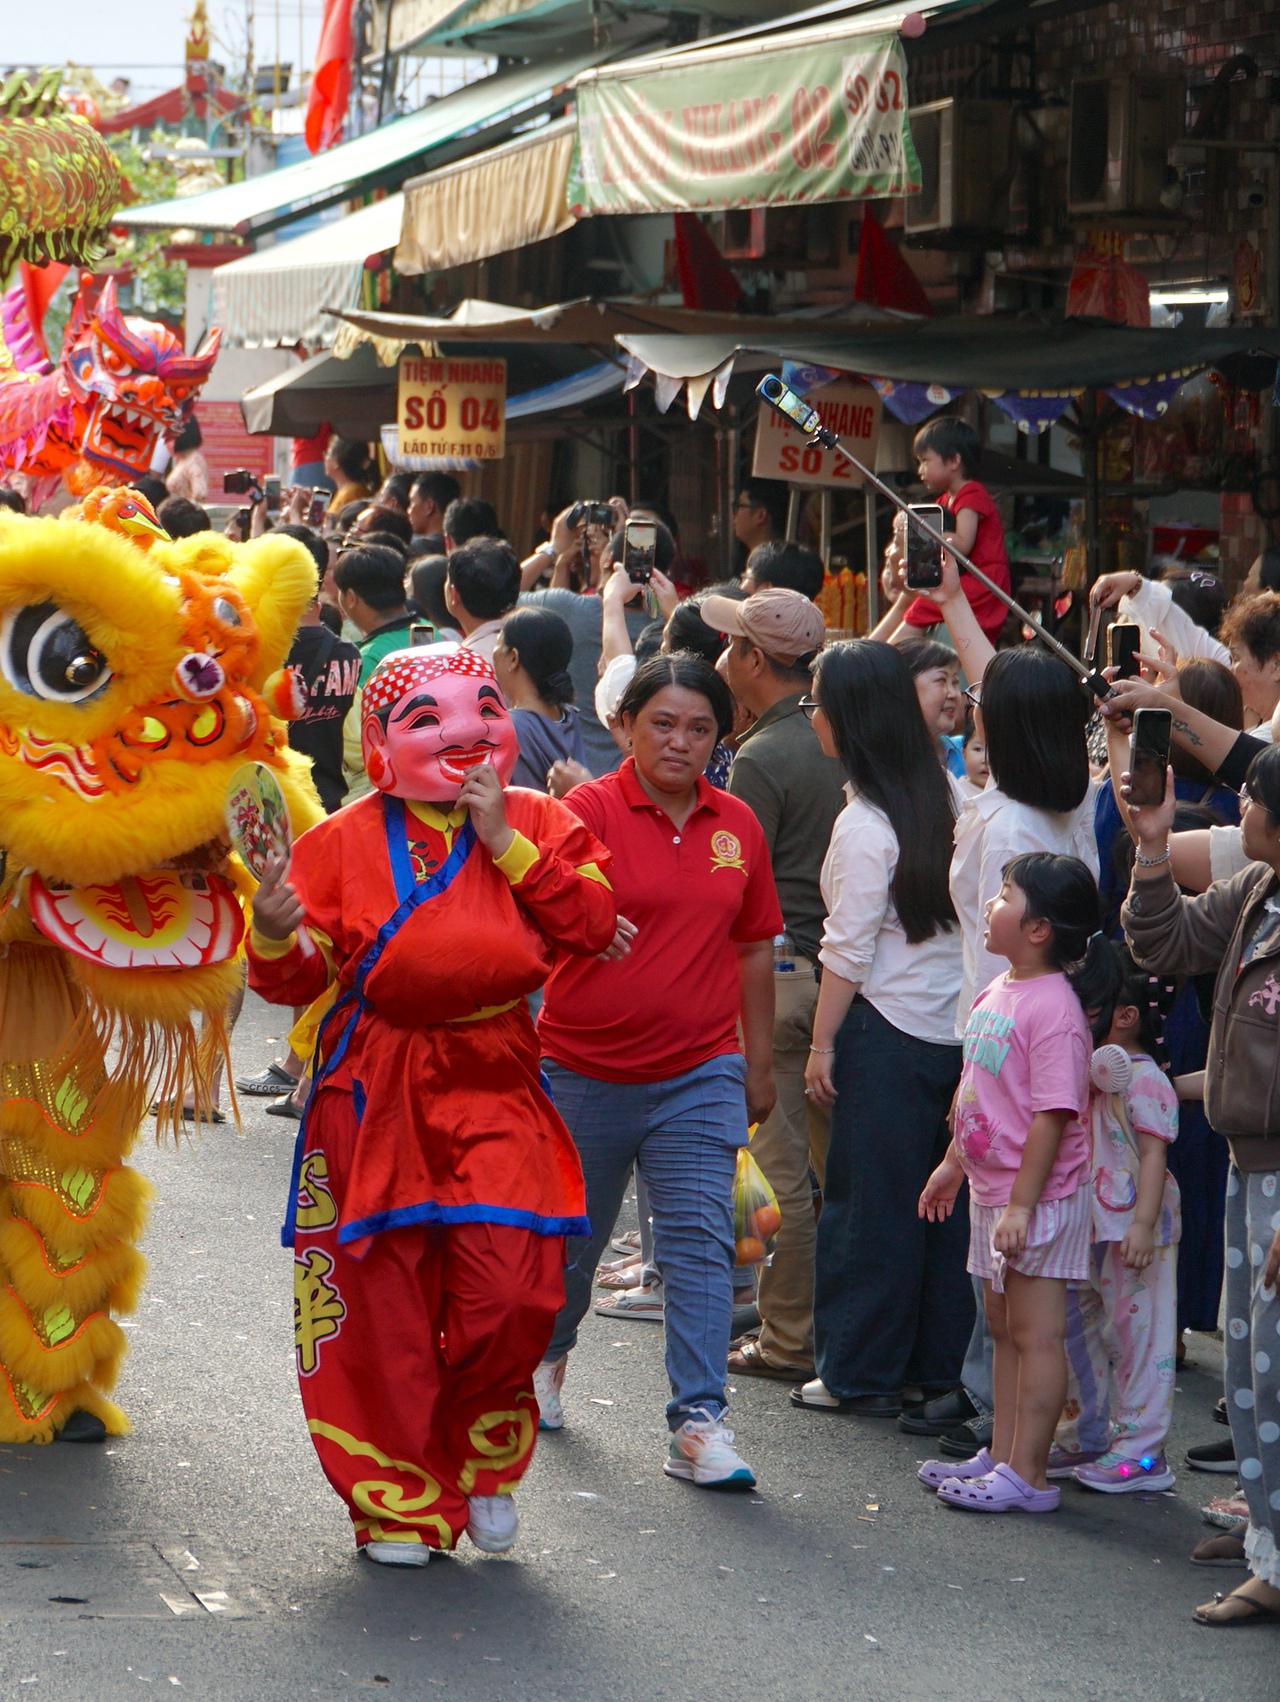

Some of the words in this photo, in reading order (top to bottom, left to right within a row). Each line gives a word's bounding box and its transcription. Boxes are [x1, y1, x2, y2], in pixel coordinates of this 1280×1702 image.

[874, 69, 904, 113] 02
[681, 93, 783, 177] NHANG
[791, 84, 839, 171] 02
[404, 361, 444, 387] TIỆM
[448, 362, 505, 385] NHANG
[404, 384, 448, 432] SỐ
[460, 396, 501, 433] 04
[816, 399, 874, 439] NHANG
[403, 438, 428, 455] LÃO
[831, 452, 852, 478] 2
